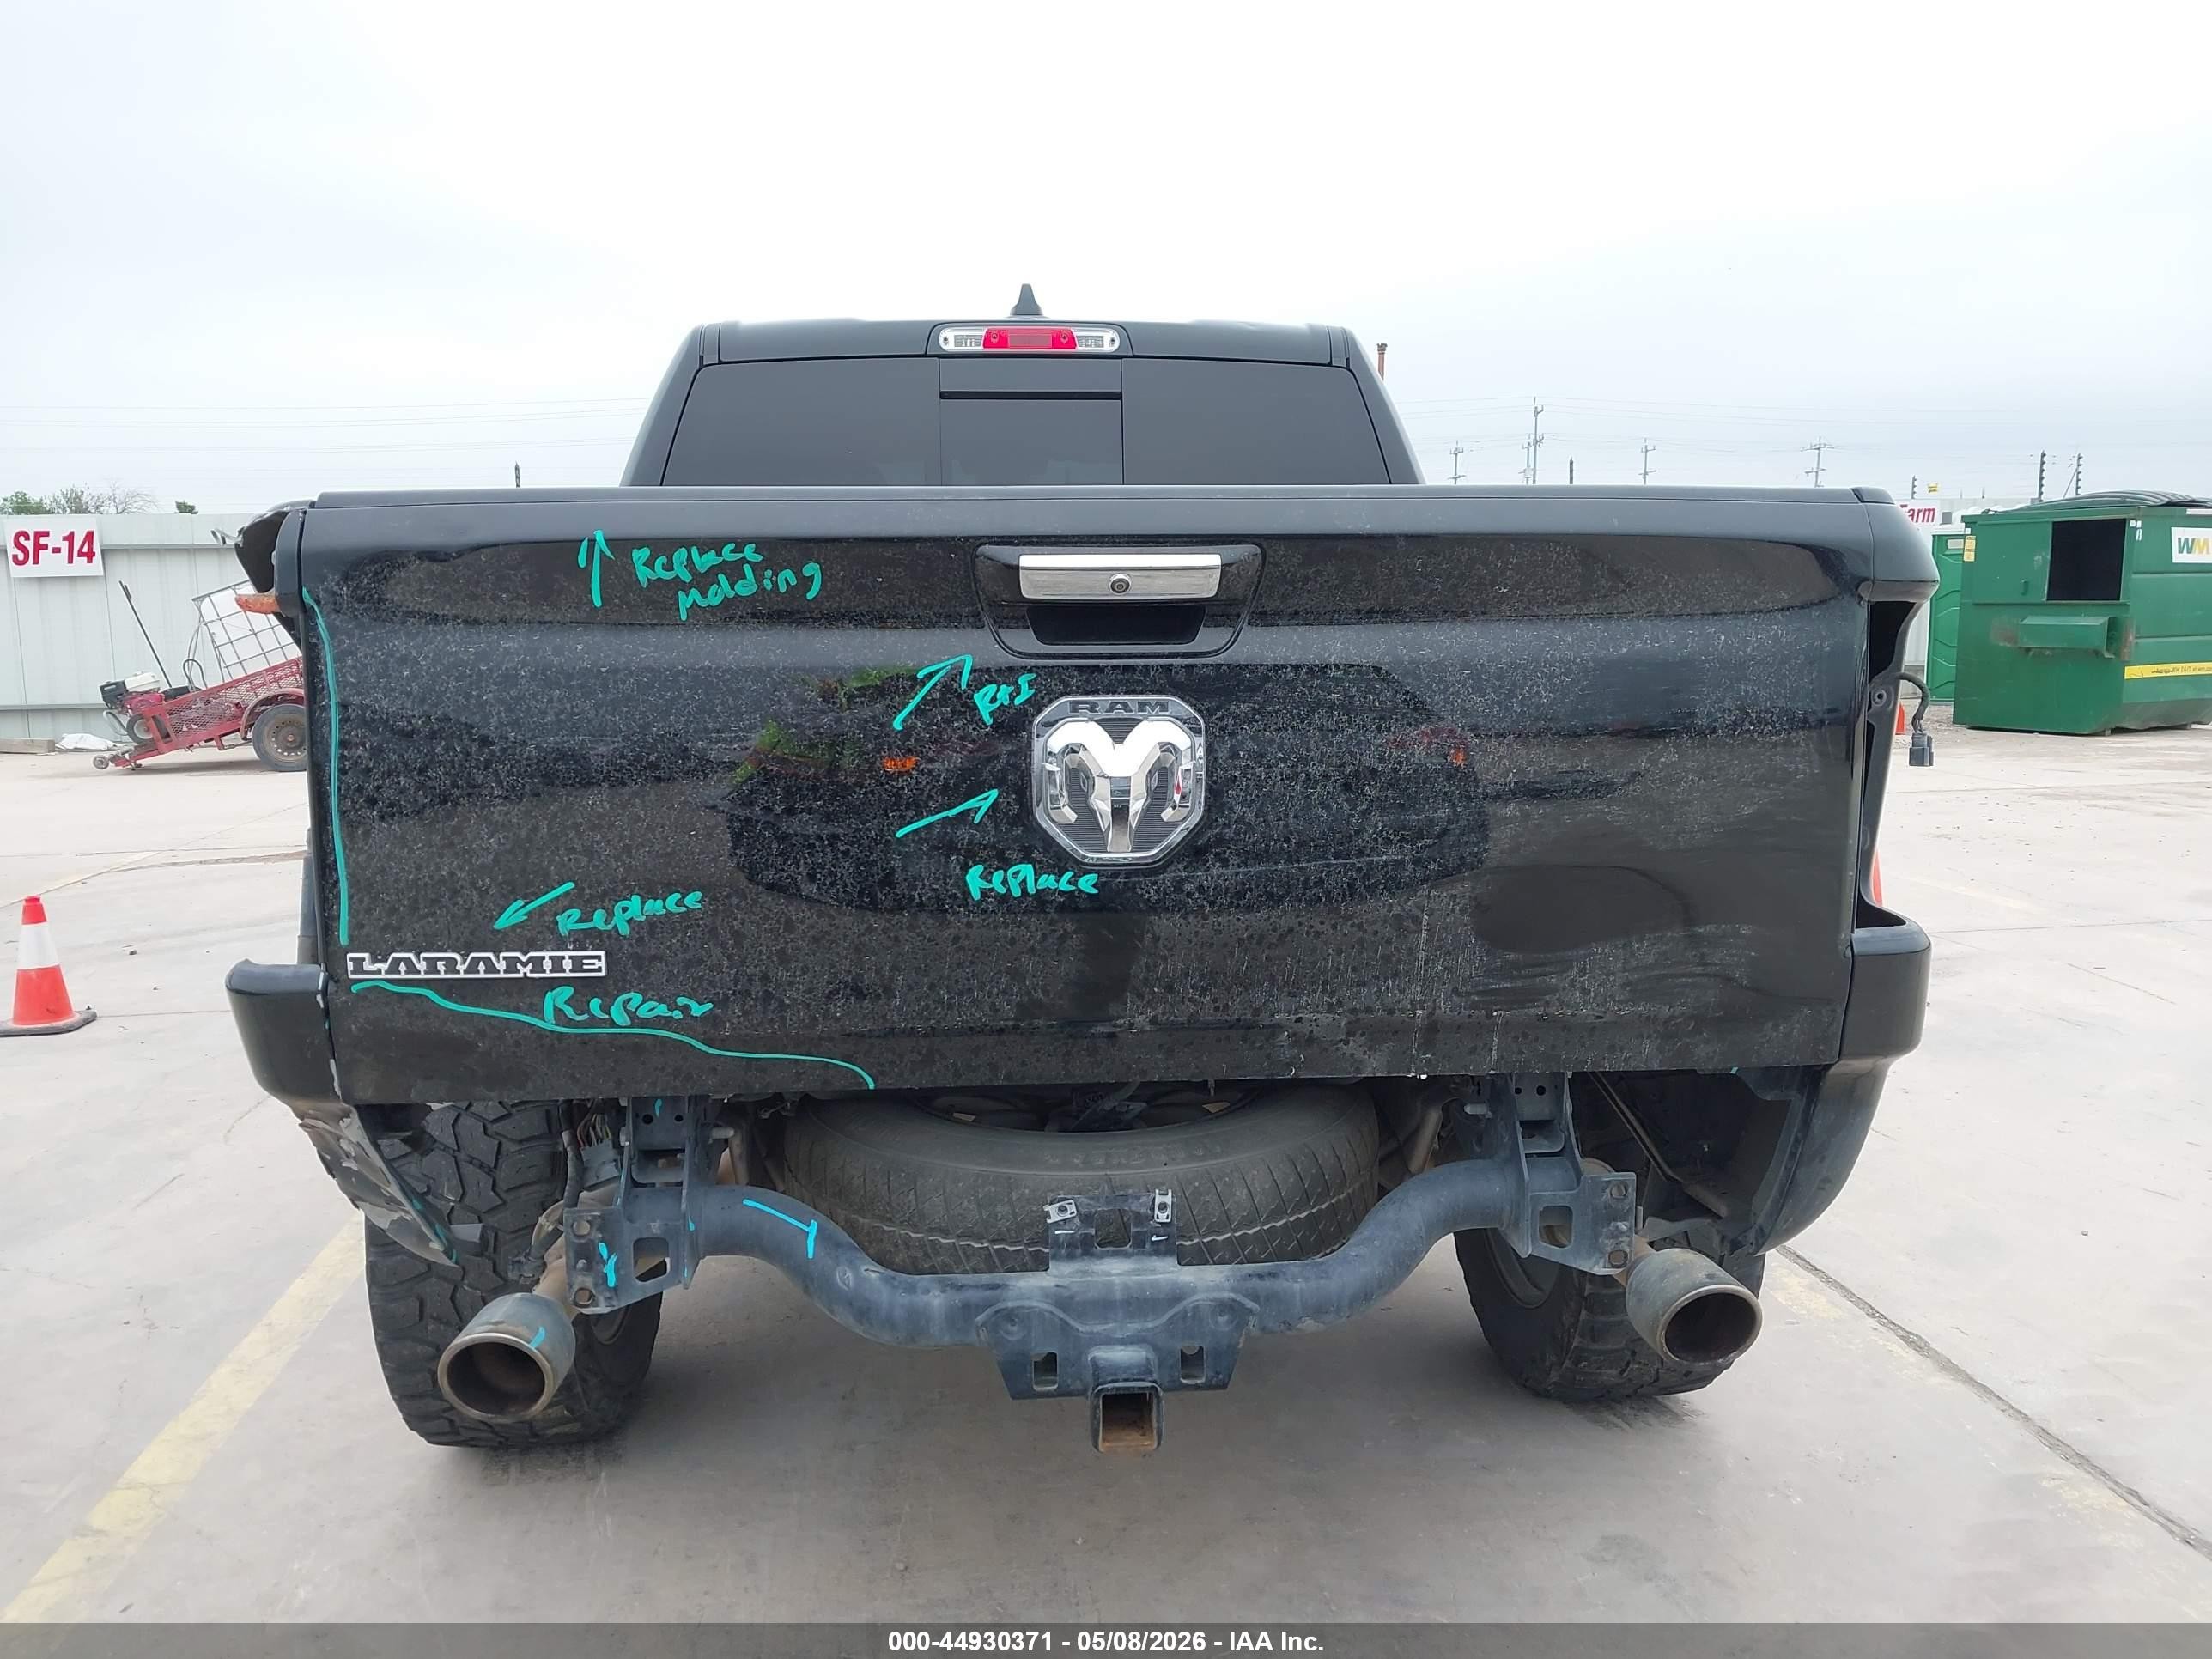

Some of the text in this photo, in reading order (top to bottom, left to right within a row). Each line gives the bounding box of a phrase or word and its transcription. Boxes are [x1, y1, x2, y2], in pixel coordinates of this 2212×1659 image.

[12, 530, 96, 566] SF-14
[2177, 537, 2210, 555] WM
[631, 542, 763, 588] Replace
[1068, 701, 1170, 714] RAM
[965, 864, 1099, 901] Replace
[556, 890, 703, 937] Replace
[347, 951, 606, 979] LARAMIE
